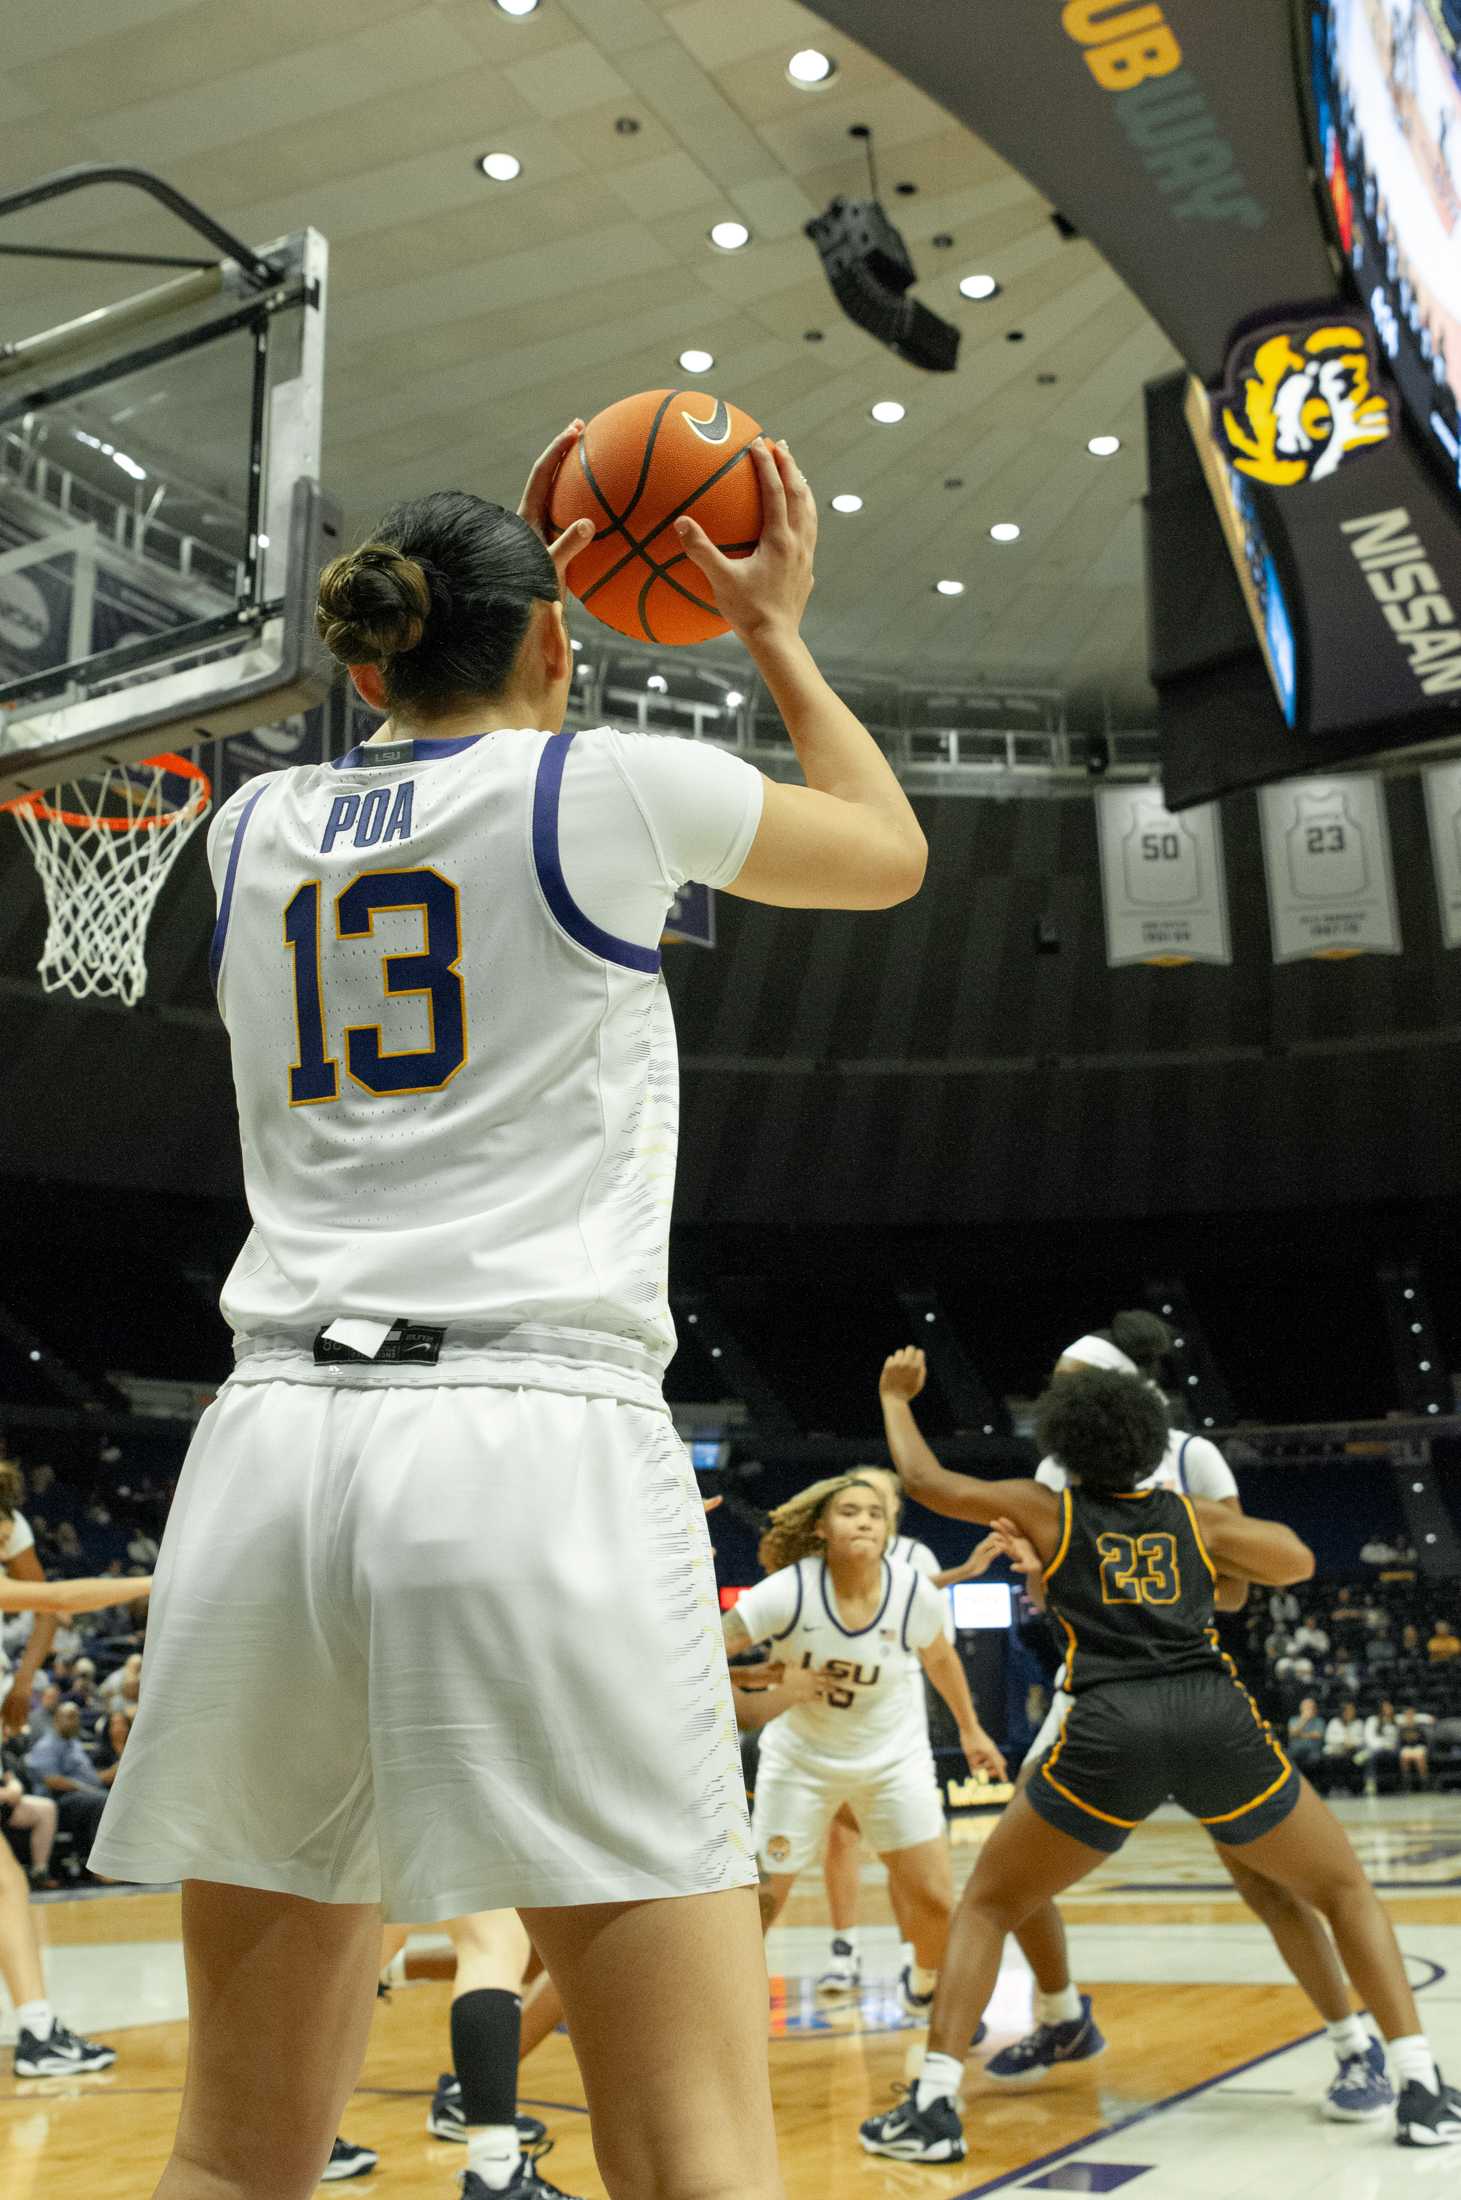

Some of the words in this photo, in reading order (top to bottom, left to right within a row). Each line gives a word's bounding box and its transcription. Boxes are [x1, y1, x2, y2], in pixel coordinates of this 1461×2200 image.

[1340, 506, 1461, 695] NISSAN
[375, 752, 400, 762] LSU
[320, 780, 414, 853] POA
[1142, 834, 1179, 860] 50
[1307, 825, 1346, 853] 23
[283, 866, 468, 1107] 13
[1096, 1532, 1182, 1605] 23
